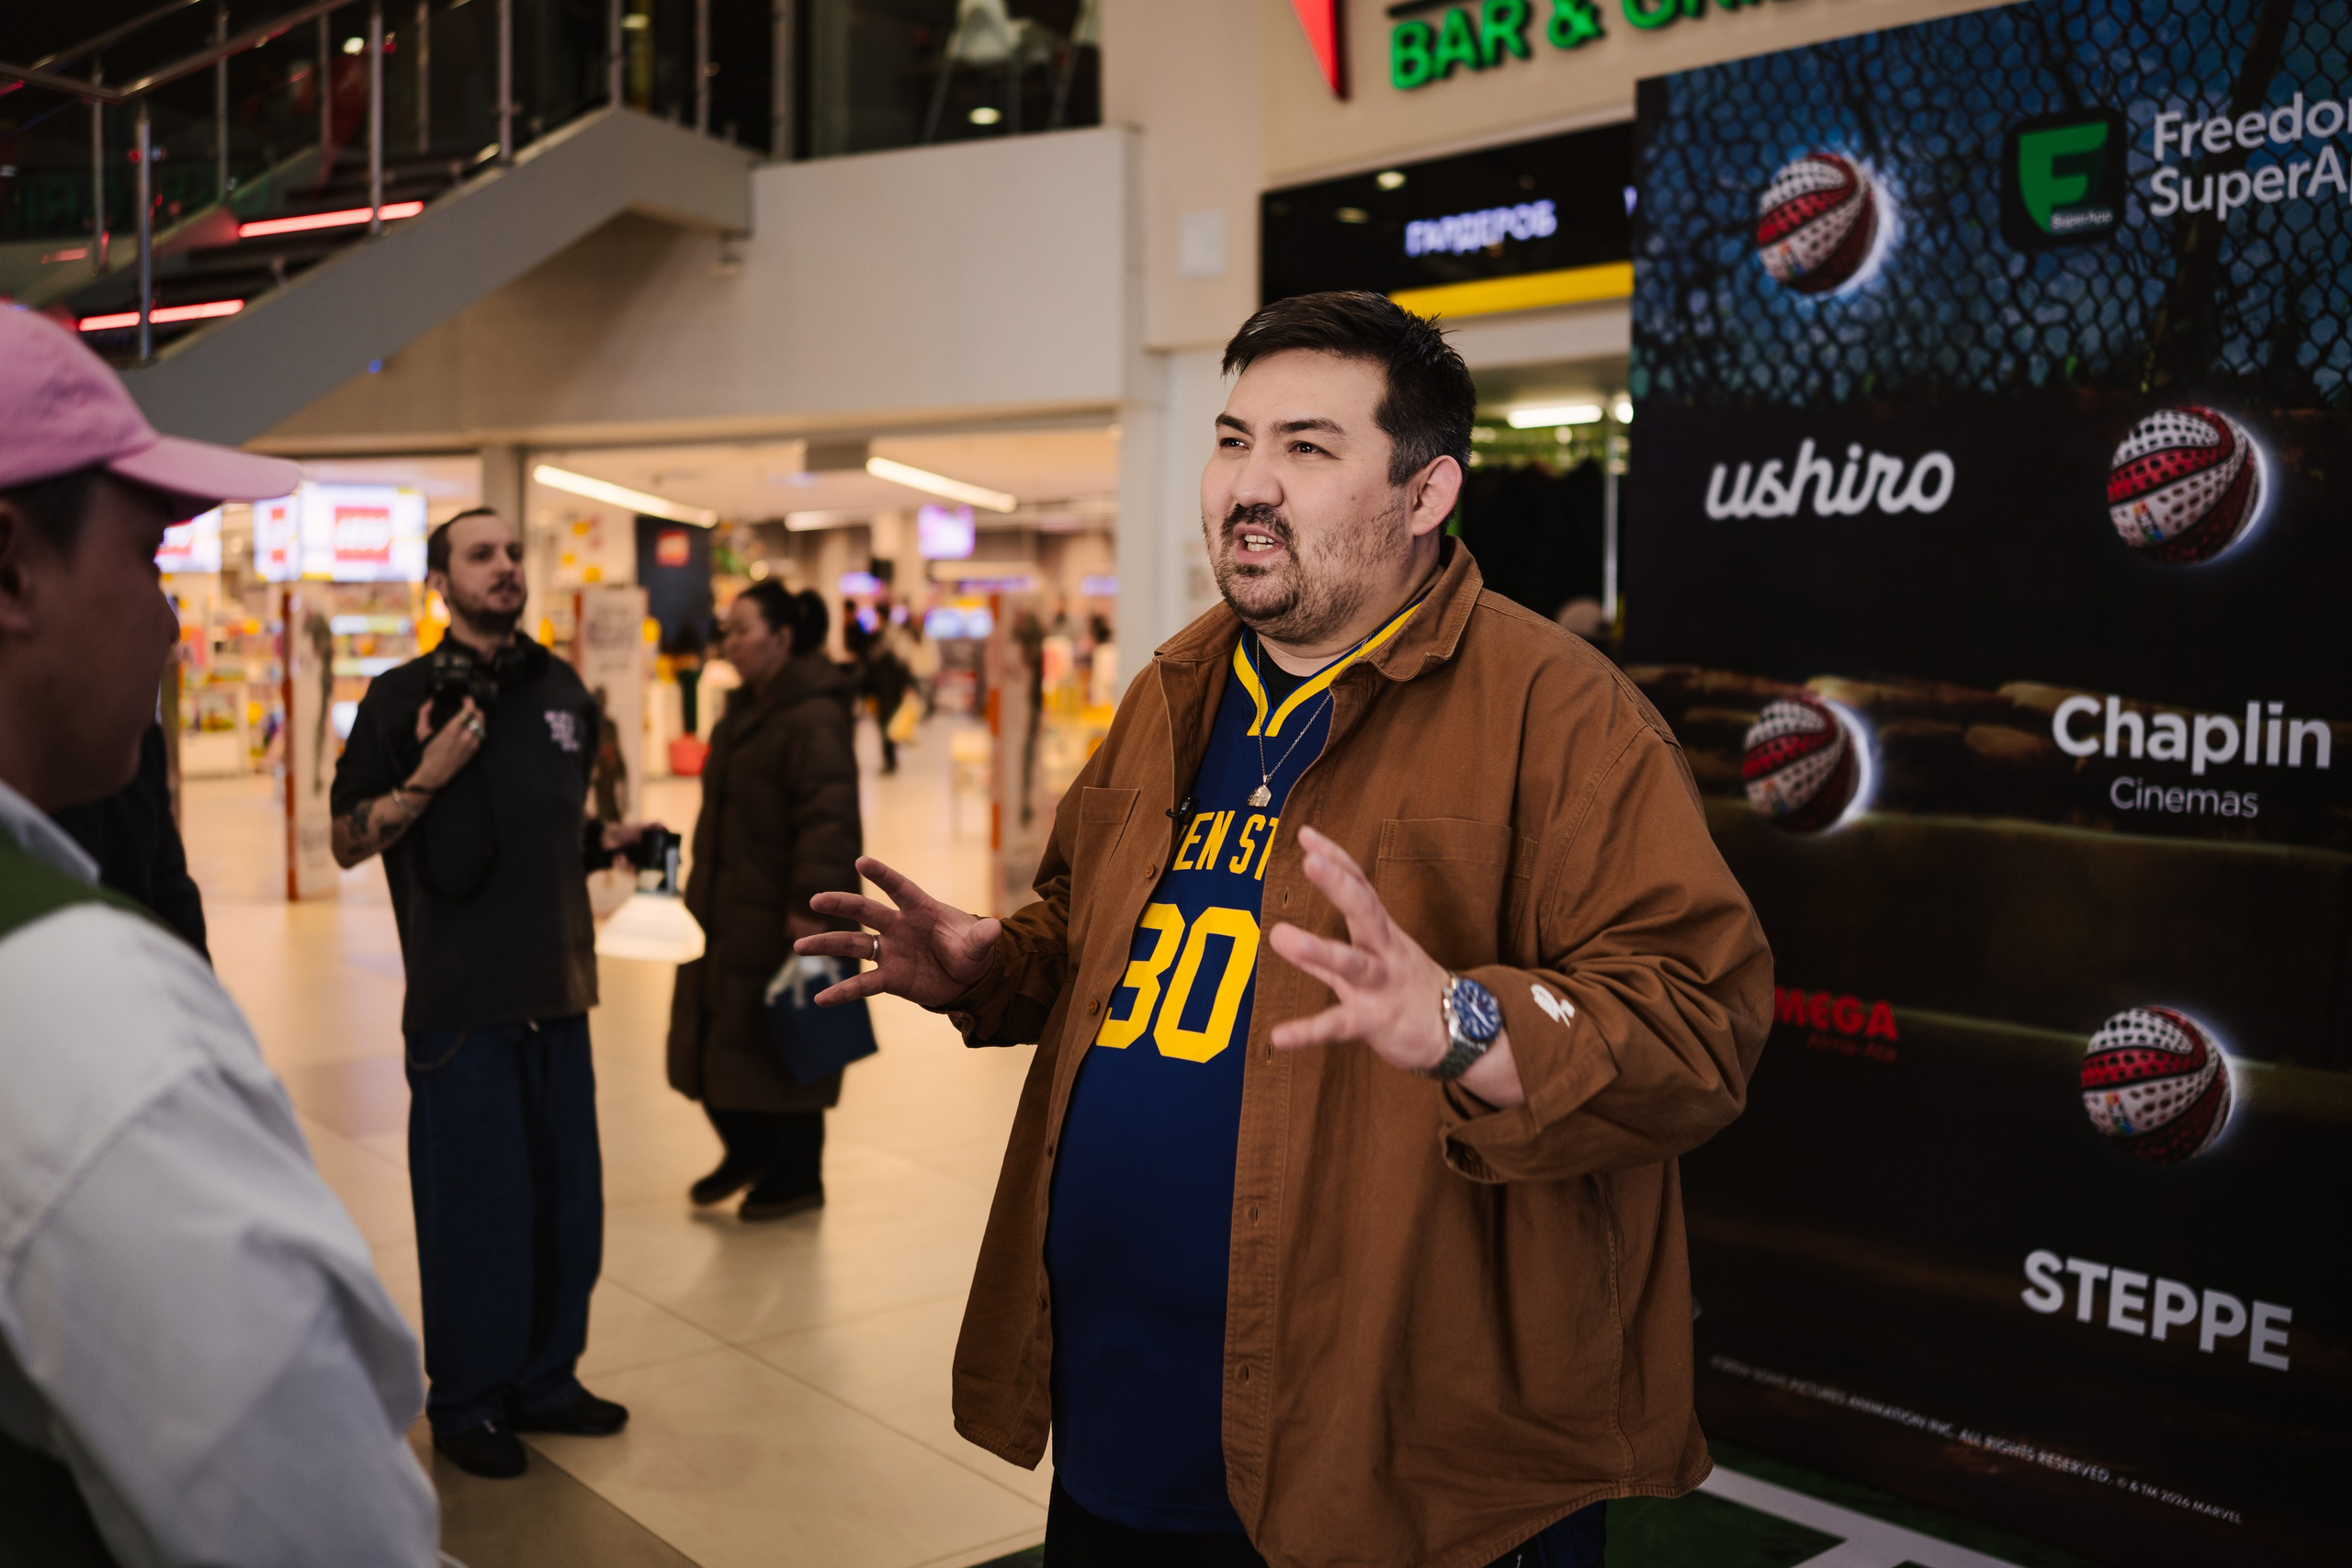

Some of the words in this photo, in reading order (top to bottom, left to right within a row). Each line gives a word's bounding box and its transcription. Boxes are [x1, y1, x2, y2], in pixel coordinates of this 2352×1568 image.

[1391, 0, 1527, 89] BAR
[2154, 91, 2352, 162] Freedo
[2150, 146, 2352, 221] SuperA
[1706, 437, 1954, 520] ushiro
[2052, 694, 2332, 775] Chaplin
[2109, 776, 2259, 818] Cinemas
[1095, 902, 1261, 1064] 30
[1773, 985, 1899, 1041] MEGA
[2020, 1248, 2293, 1372] STEPPE
[1958, 1427, 1983, 1448] ALL
[1984, 1435, 2035, 1461] RIGHTS
[2159, 1488, 2191, 1509] 2026
[2192, 1499, 2242, 1526] MARVEL
